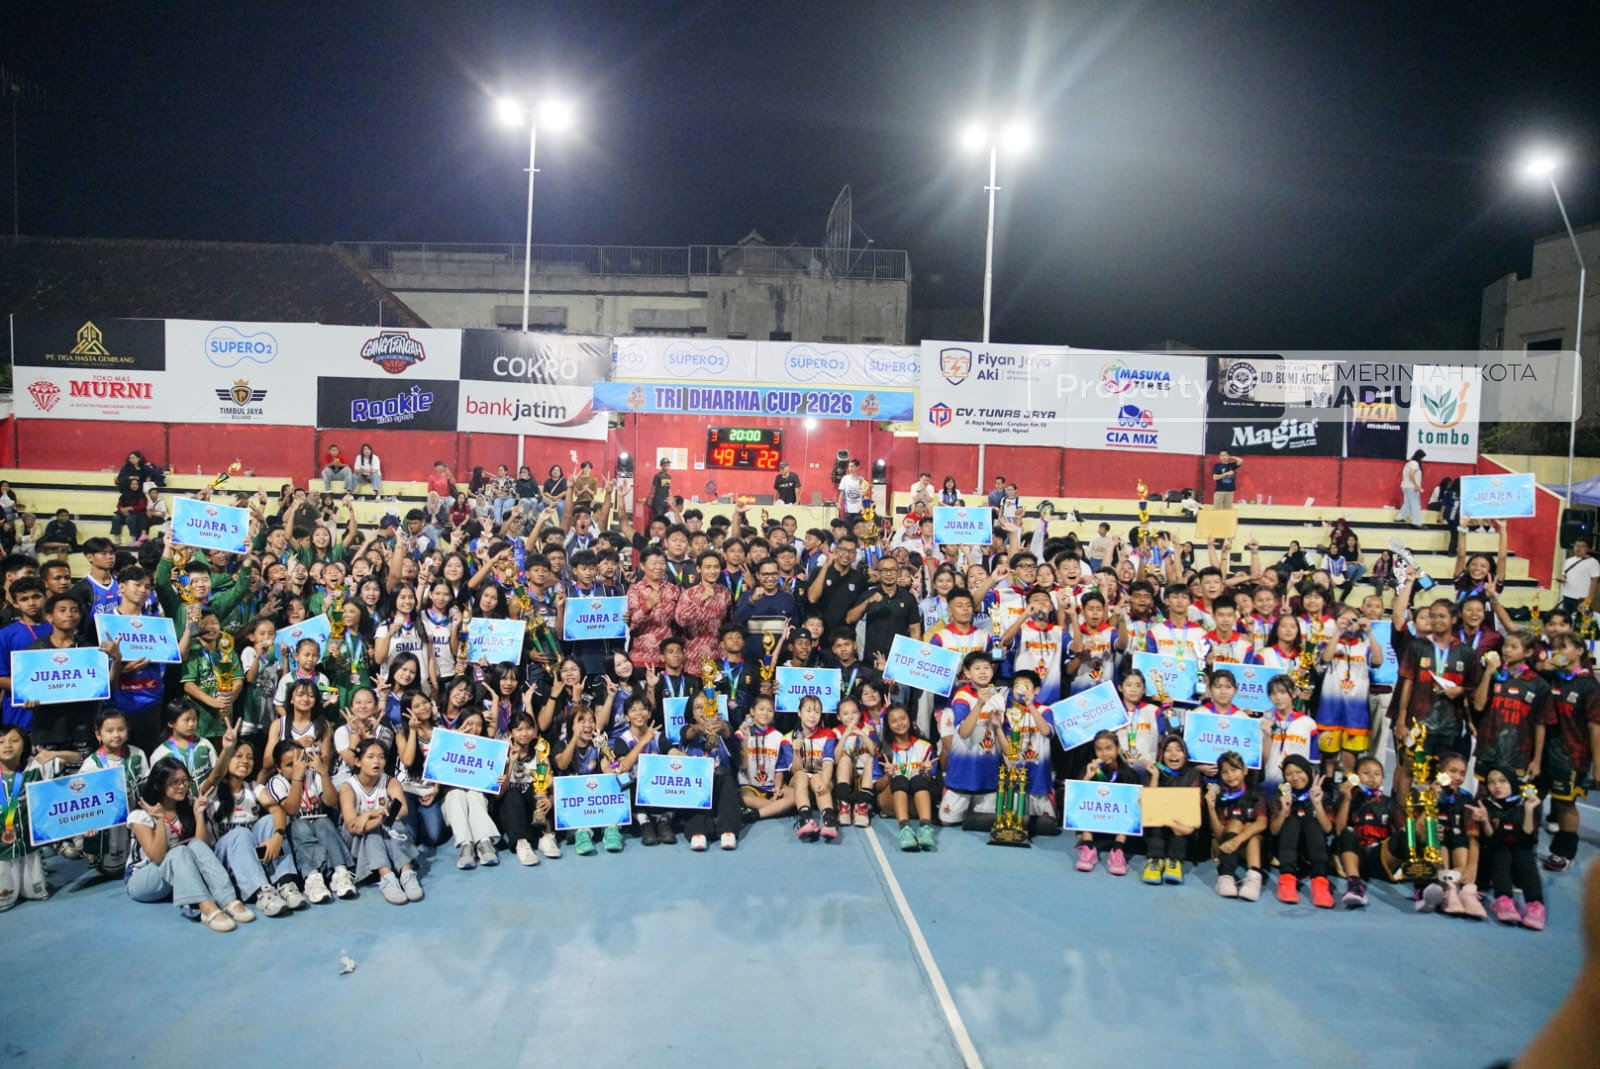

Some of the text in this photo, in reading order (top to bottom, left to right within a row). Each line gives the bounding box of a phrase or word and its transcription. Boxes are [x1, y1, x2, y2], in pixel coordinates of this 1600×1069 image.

[978, 352, 1016, 368] Fiyan
[492, 356, 579, 380] COKRO
[976, 369, 999, 380] Aki
[1120, 368, 1171, 381] MASUKA
[1260, 372, 1273, 383] UD
[68, 380, 154, 400] MURNI
[351, 386, 434, 422] Rookie
[654, 388, 853, 415] TRI DHARMA CUP 2026
[220, 407, 245, 415] TIMBUL
[978, 409, 1022, 418] TUNAS
[1366, 422, 1400, 430] madiun
[729, 428, 762, 442] 20:00
[1106, 432, 1158, 444] CIA MIX
[1231, 418, 1316, 450] Magia
[1418, 428, 1470, 446] tombo
[714, 448, 734, 467] 49
[741, 450, 748, 460] 4
[757, 450, 778, 469] 22
[1476, 492, 1512, 501] JUARA
[186, 518, 239, 534] JUARA 3
[944, 521, 984, 530] JUARA 2
[576, 612, 619, 624] JUARA 2
[160, 635, 168, 644] 4
[474, 637, 504, 646] JUARA
[894, 652, 951, 678] TOP SCORE
[30, 668, 96, 682] JUARA 4
[1162, 672, 1178, 682] VP
[788, 685, 832, 696] JUARA 3
[1060, 714, 1080, 730] TOP
[1082, 700, 1117, 721] SCORE
[1198, 732, 1252, 748] JUARA 2
[442, 752, 494, 770] JUARA 4
[651, 776, 702, 788] JUARA 4
[48, 792, 115, 816] JUARA 3
[561, 794, 625, 808] TOP SCORE
[1078, 800, 1128, 814] JUARA 1
[70, 812, 96, 822] UPPER
